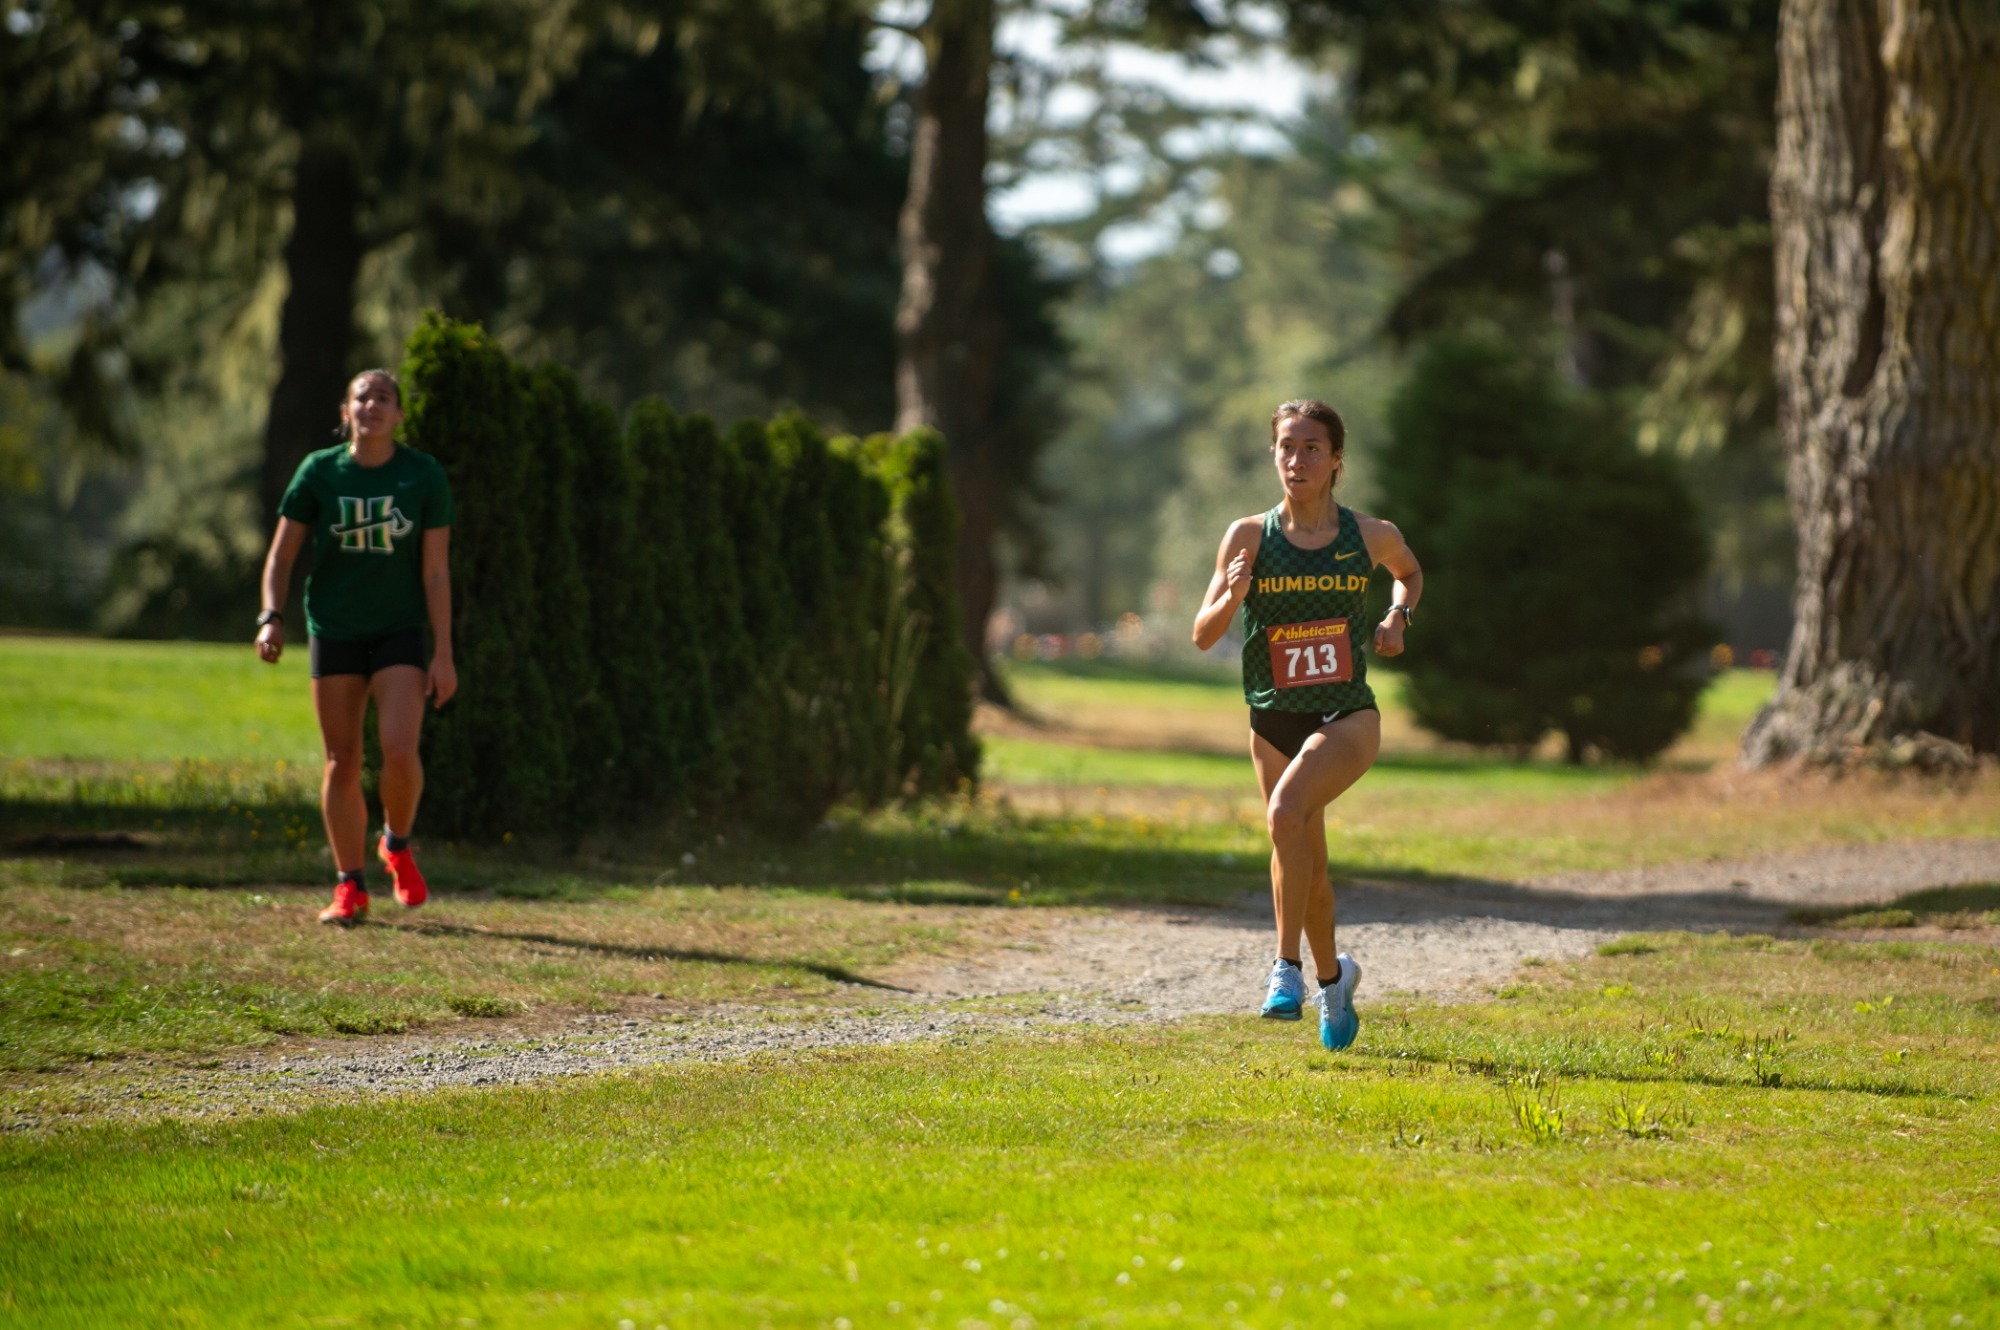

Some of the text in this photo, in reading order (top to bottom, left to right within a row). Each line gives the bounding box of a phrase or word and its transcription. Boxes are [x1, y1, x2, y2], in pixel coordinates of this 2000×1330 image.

[338, 495, 394, 554] H
[1258, 575, 1368, 593] HUMBOLDT
[1285, 643, 1338, 678] 713
